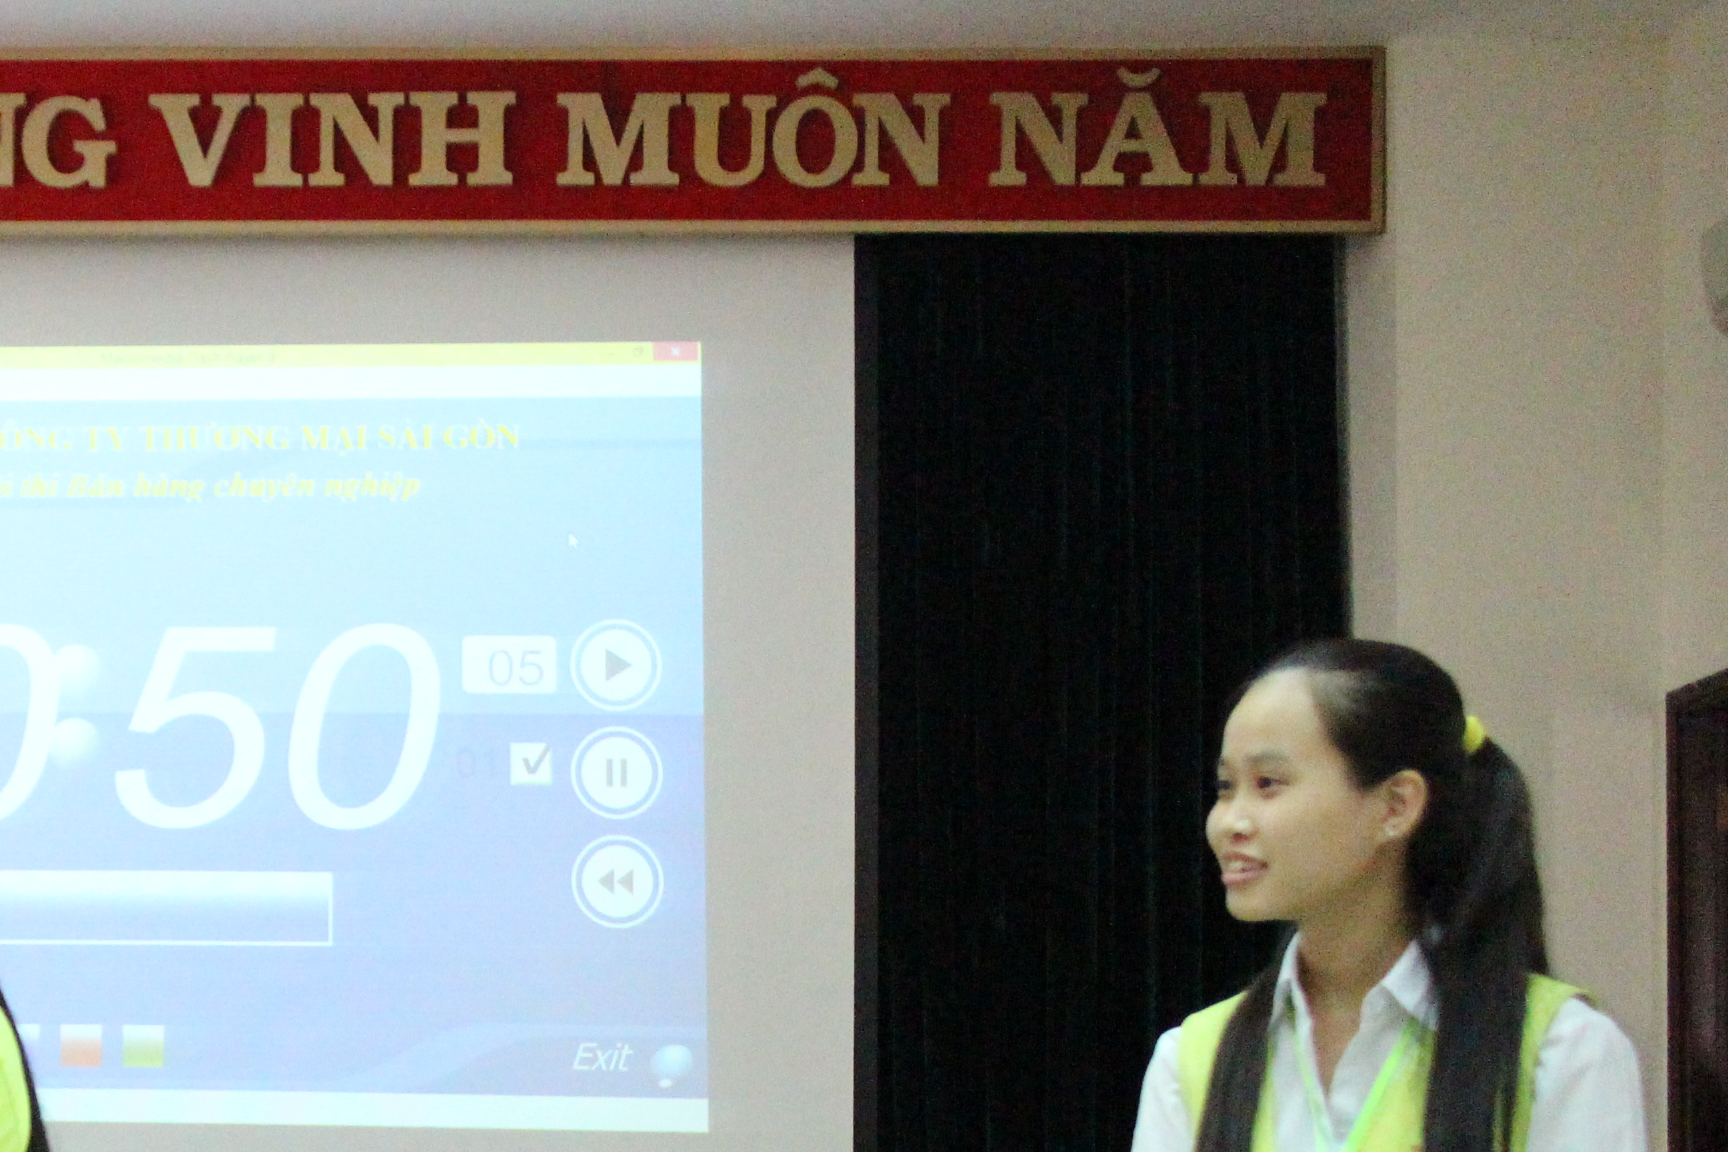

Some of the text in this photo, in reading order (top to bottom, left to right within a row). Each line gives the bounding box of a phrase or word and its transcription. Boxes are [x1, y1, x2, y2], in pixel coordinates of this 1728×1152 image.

[149, 91, 516, 188] VINH
[556, 67, 951, 188] MUÔN
[988, 67, 1327, 188] NĂM
[83, 425, 131, 452] TY
[488, 649, 545, 687] 05
[572, 1041, 634, 1072] Exit
